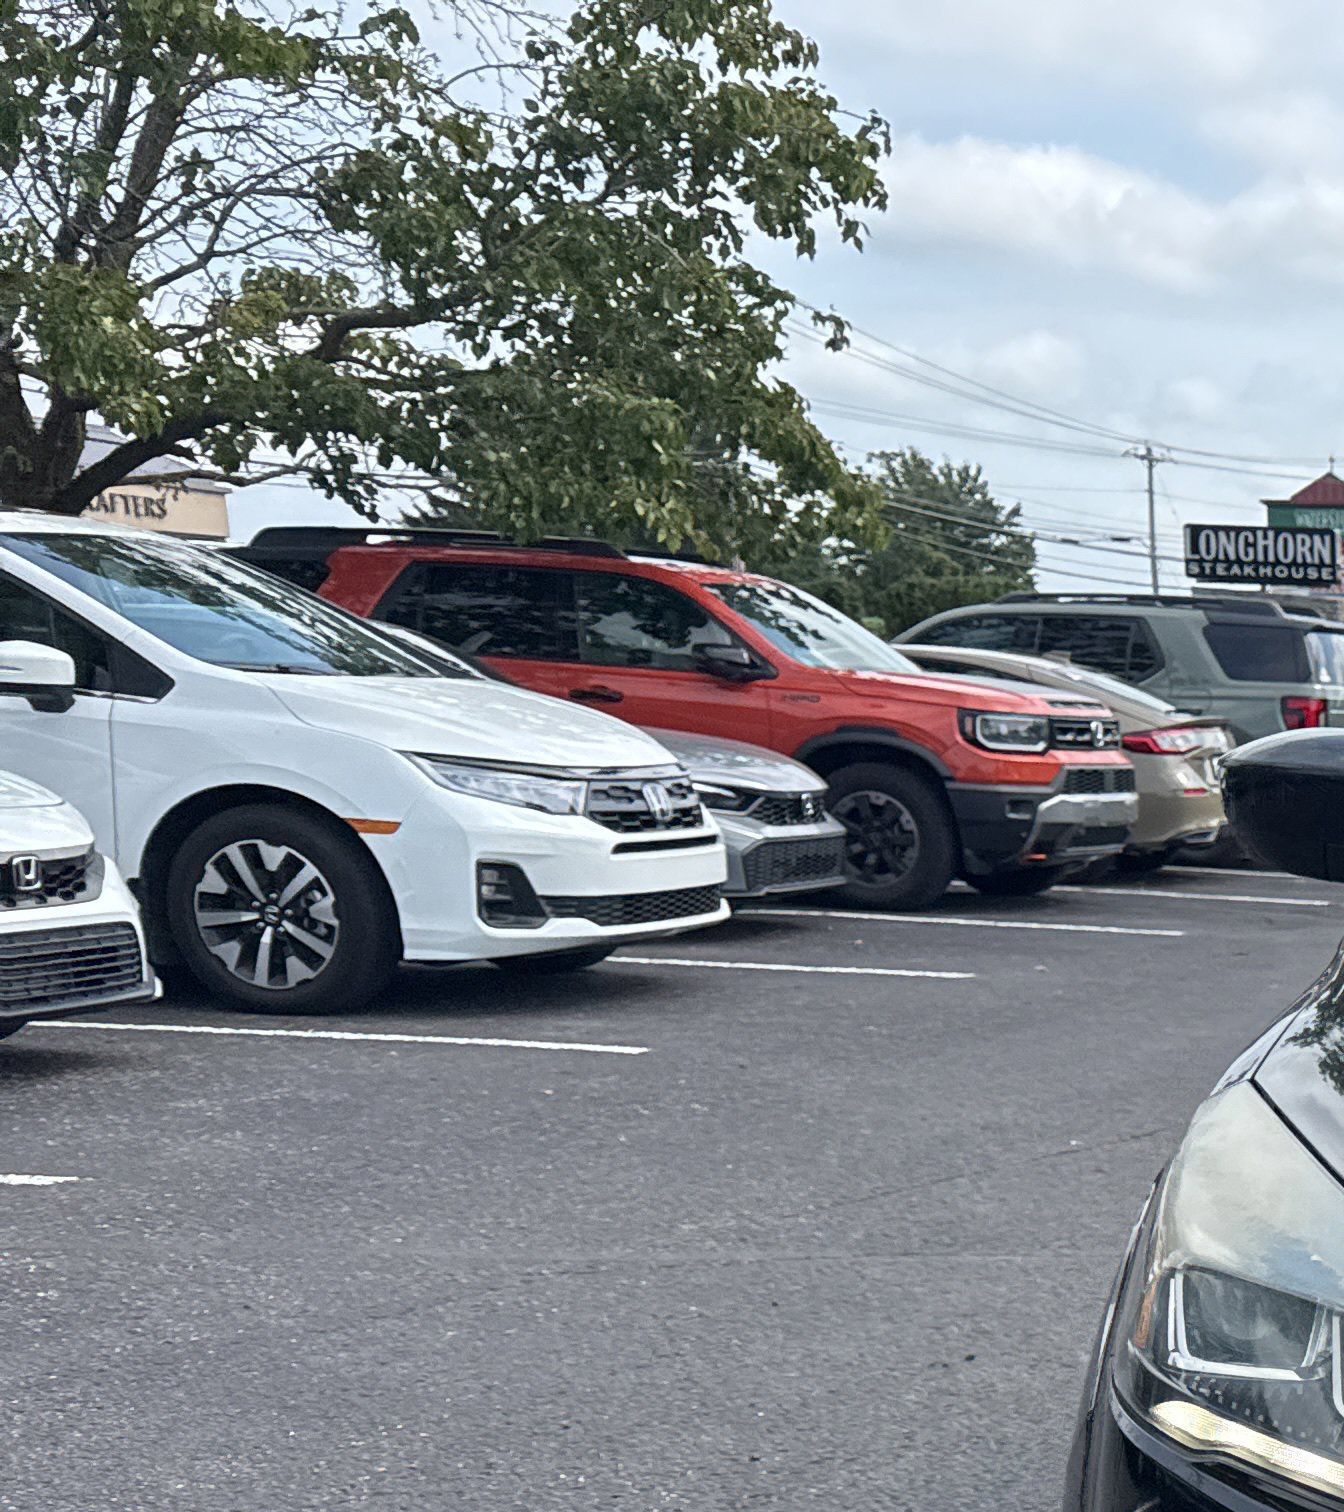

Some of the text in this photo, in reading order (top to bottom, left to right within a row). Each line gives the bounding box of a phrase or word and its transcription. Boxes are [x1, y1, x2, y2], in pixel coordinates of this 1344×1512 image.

[88, 493, 167, 519] AFTERS
[1185, 529, 1332, 566] LONGHORN
[1187, 562, 1334, 581] STEAKHOUSE
